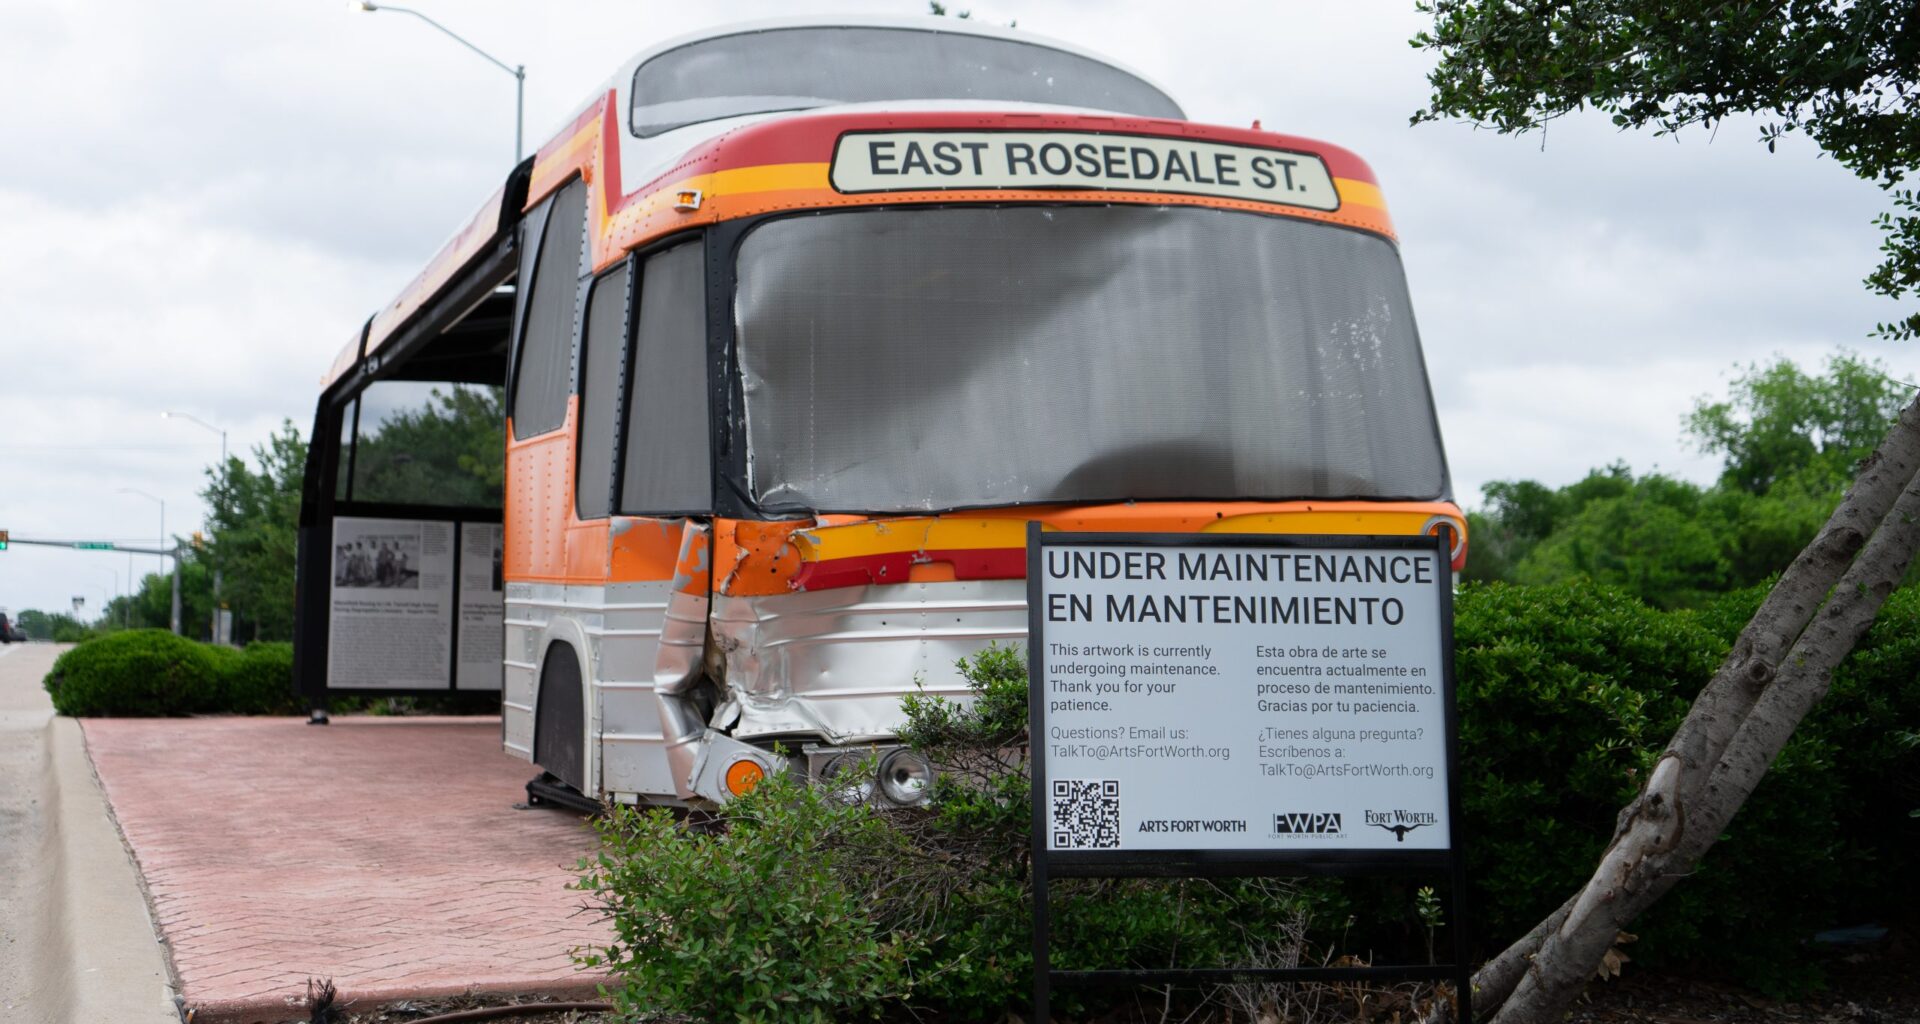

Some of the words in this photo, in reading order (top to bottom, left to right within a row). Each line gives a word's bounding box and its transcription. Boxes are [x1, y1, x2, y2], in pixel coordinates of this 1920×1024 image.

[869, 141, 989, 175] EAST
[1006, 143, 1240, 186] ROSEDALE
[1250, 156, 1307, 191] ST.
[1048, 551, 1166, 580] UNDER
[1178, 552, 1432, 584] MAINTENANCE
[1048, 594, 1093, 622] EN
[1106, 595, 1404, 625] MANTENIMIENTO
[1050, 644, 1079, 656] This
[1083, 644, 1134, 656] artwork
[1138, 645, 1150, 656] is
[1153, 645, 1212, 659] currently
[1256, 646, 1285, 658] Esta
[1289, 646, 1319, 658] obra
[1322, 646, 1338, 658] de
[1342, 648, 1368, 658] arte
[1371, 649, 1387, 658] se
[1050, 662, 1126, 677] undergoing
[1130, 663, 1221, 675] maintenance.
[1256, 665, 1322, 676] encuentra
[1326, 664, 1408, 676] actualmente
[1410, 667, 1427, 677] en
[1050, 680, 1093, 693] Thank
[1095, 683, 1119, 696] you
[1123, 681, 1144, 693] for
[1146, 683, 1176, 696] your
[1257, 683, 1311, 697] proceso
[1314, 682, 1331, 694] de
[1334, 683, 1436, 695] mantenimiento.
[1050, 699, 1112, 712] patience.
[1257, 700, 1308, 712] Gracias
[1311, 702, 1333, 715] por
[1337, 702, 1350, 712] tu
[1353, 701, 1420, 715] paciencia.
[1051, 726, 1125, 740] Questions?
[1129, 727, 1166, 739] Email
[1168, 729, 1189, 739] us:
[1258, 726, 1309, 742] ¿Tienes
[1312, 727, 1355, 742] alguna
[1359, 727, 1423, 743] pregunta?
[1051, 745, 1231, 760] TalkTo@ArtsFortWorth.org
[1258, 746, 1331, 758] Escríbenos
[1334, 748, 1346, 758] a:
[1259, 764, 1434, 778] TalkTo@ArtsFortWorth.org
[1139, 820, 1168, 832] ARTS
[1171, 820, 1201, 832] FORT
[1202, 820, 1247, 833] WORTH
[1273, 813, 1341, 833] FWPA
